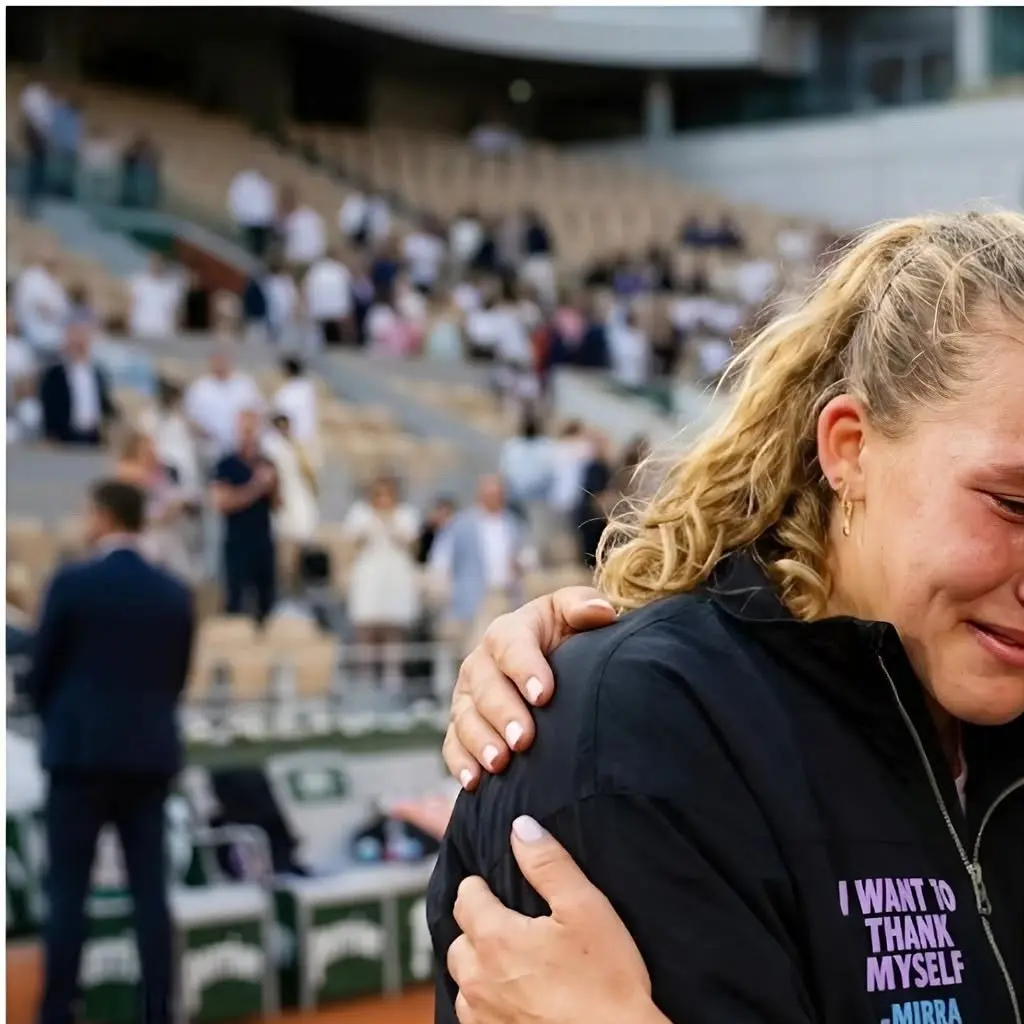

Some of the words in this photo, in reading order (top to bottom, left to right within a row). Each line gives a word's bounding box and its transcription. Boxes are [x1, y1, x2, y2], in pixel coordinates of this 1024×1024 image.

[838, 880, 849, 916] I
[854, 878, 927, 915] WANT
[929, 878, 957, 912] TO
[864, 914, 955, 953] THANK
[866, 950, 965, 992] MYSELF
